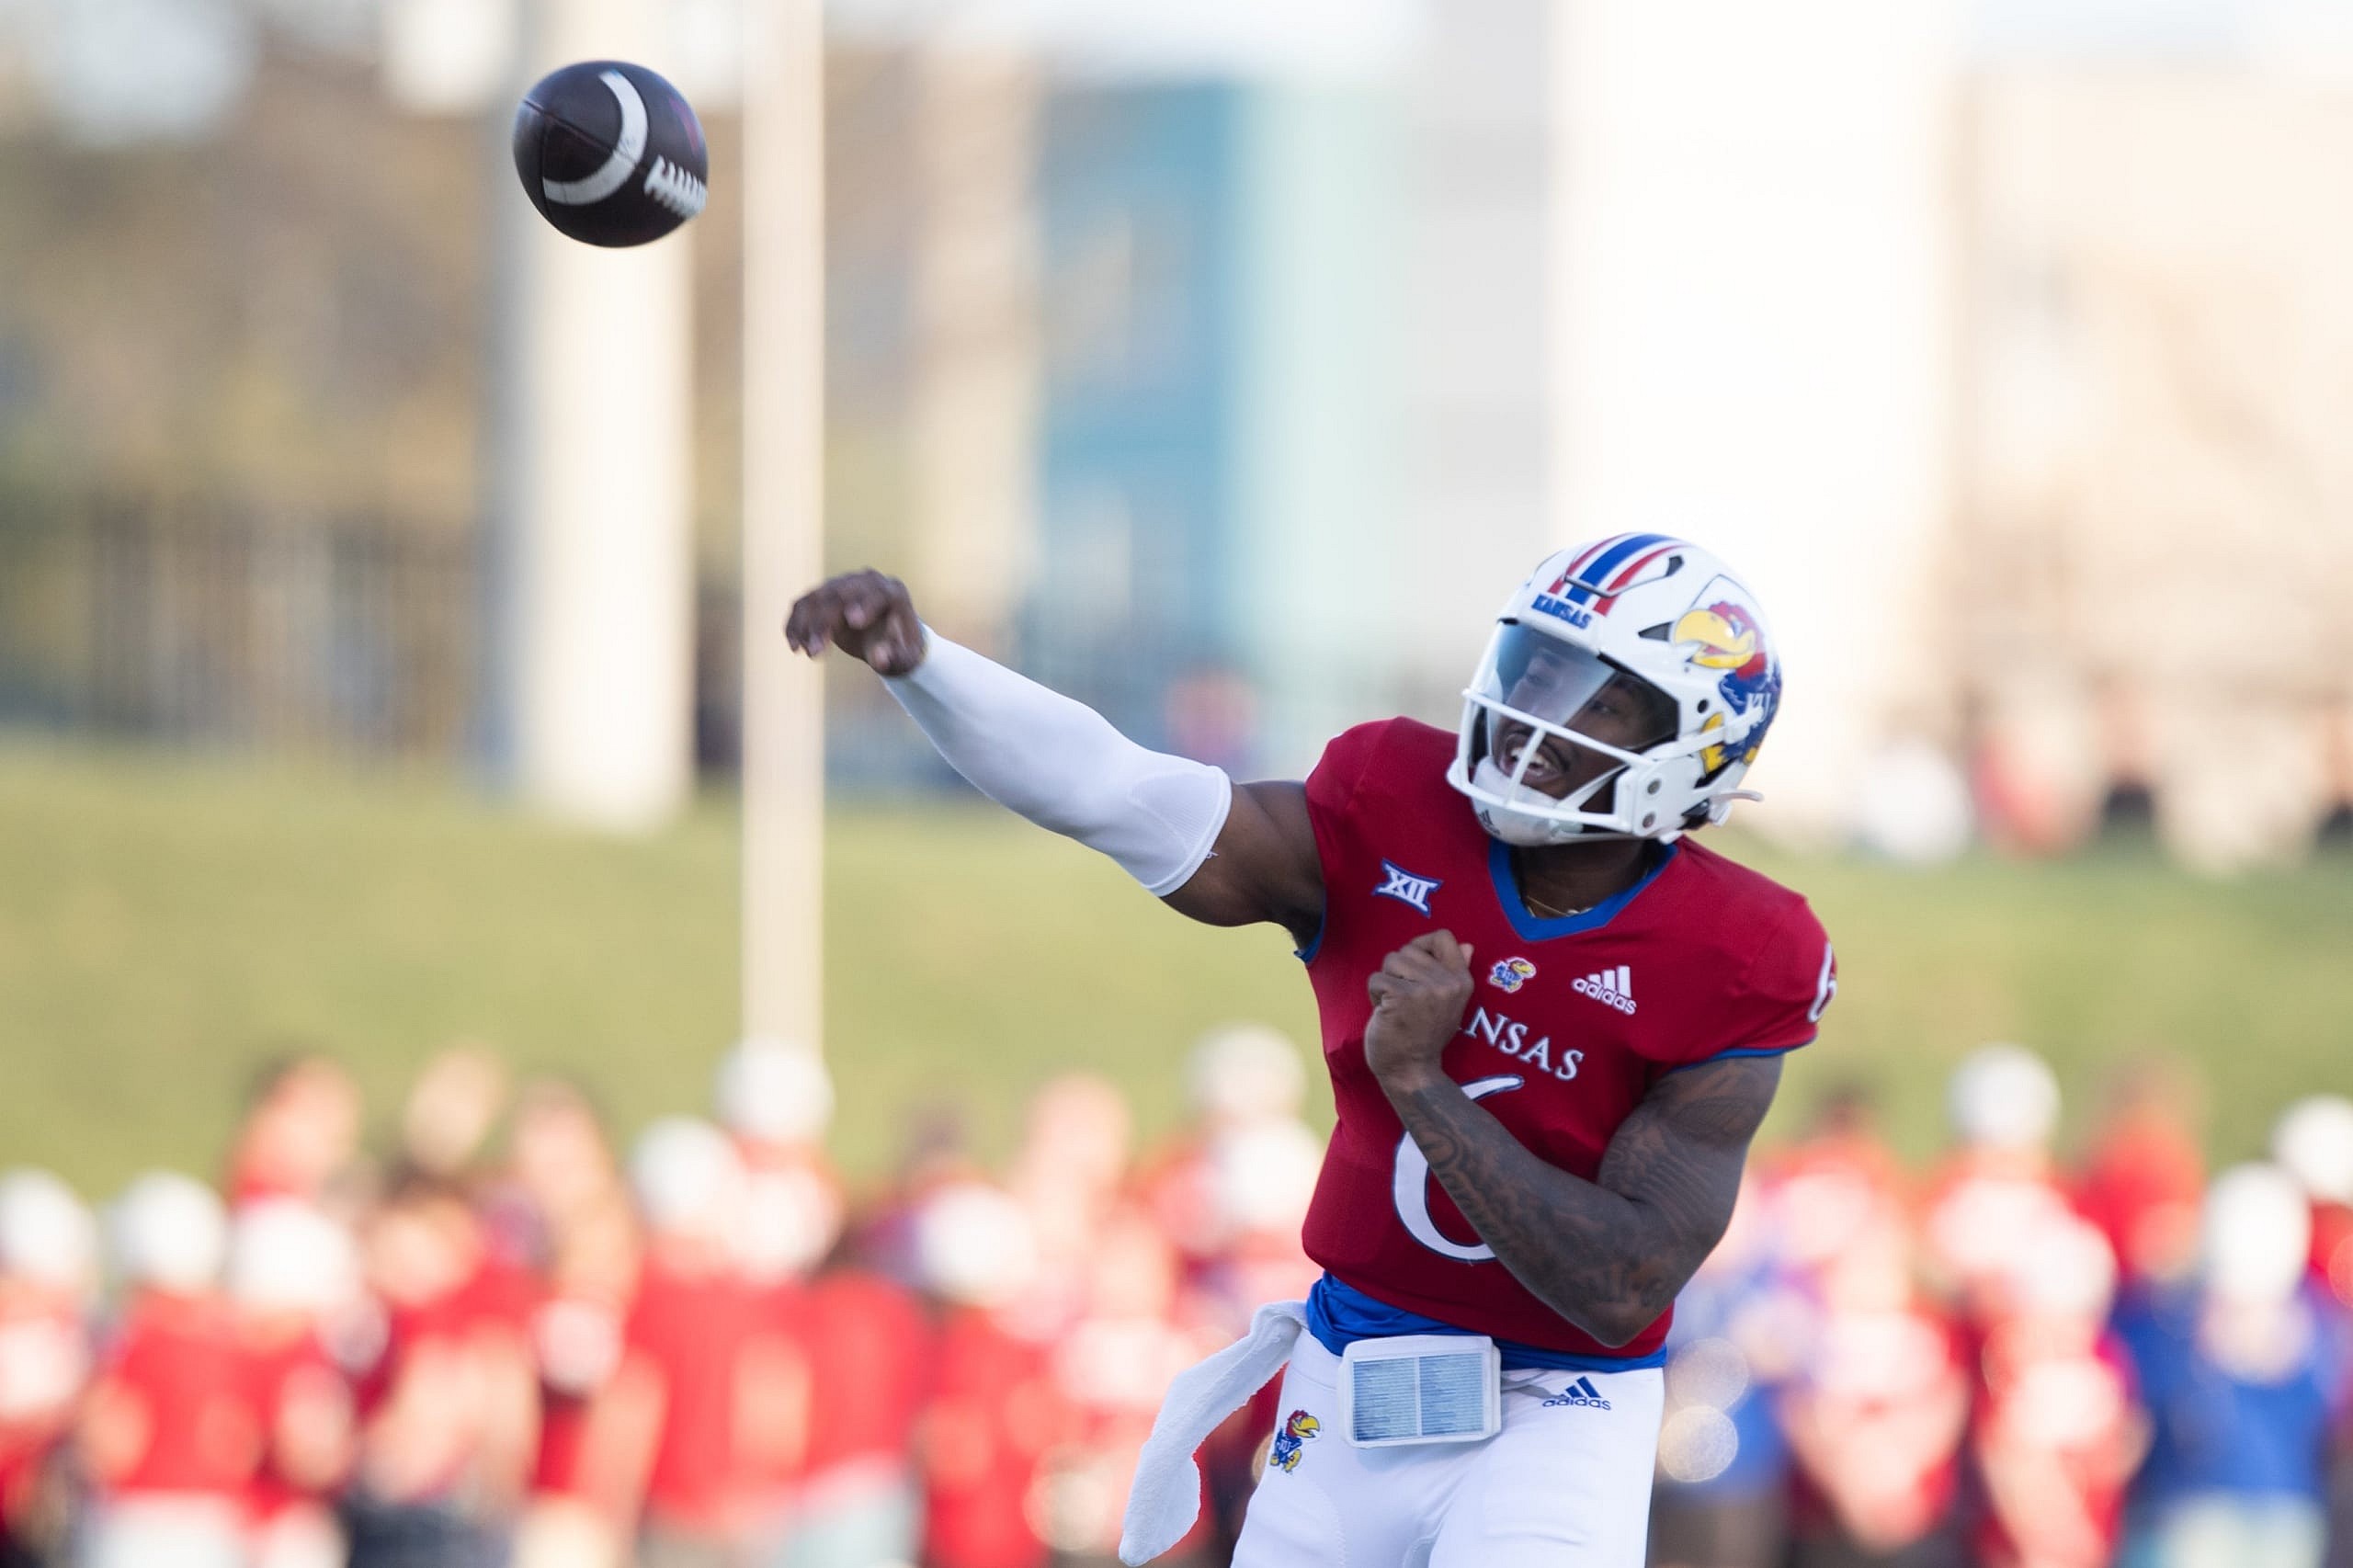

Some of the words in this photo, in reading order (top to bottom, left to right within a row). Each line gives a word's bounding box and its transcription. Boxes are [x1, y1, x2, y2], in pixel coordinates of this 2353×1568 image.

[1530, 594, 1592, 629] KANSAS
[1375, 860, 1440, 915] XII
[1571, 977, 1637, 1016] adidas
[1459, 1006, 1585, 1081] NSAS
[1542, 1393, 1611, 1411] adidas
